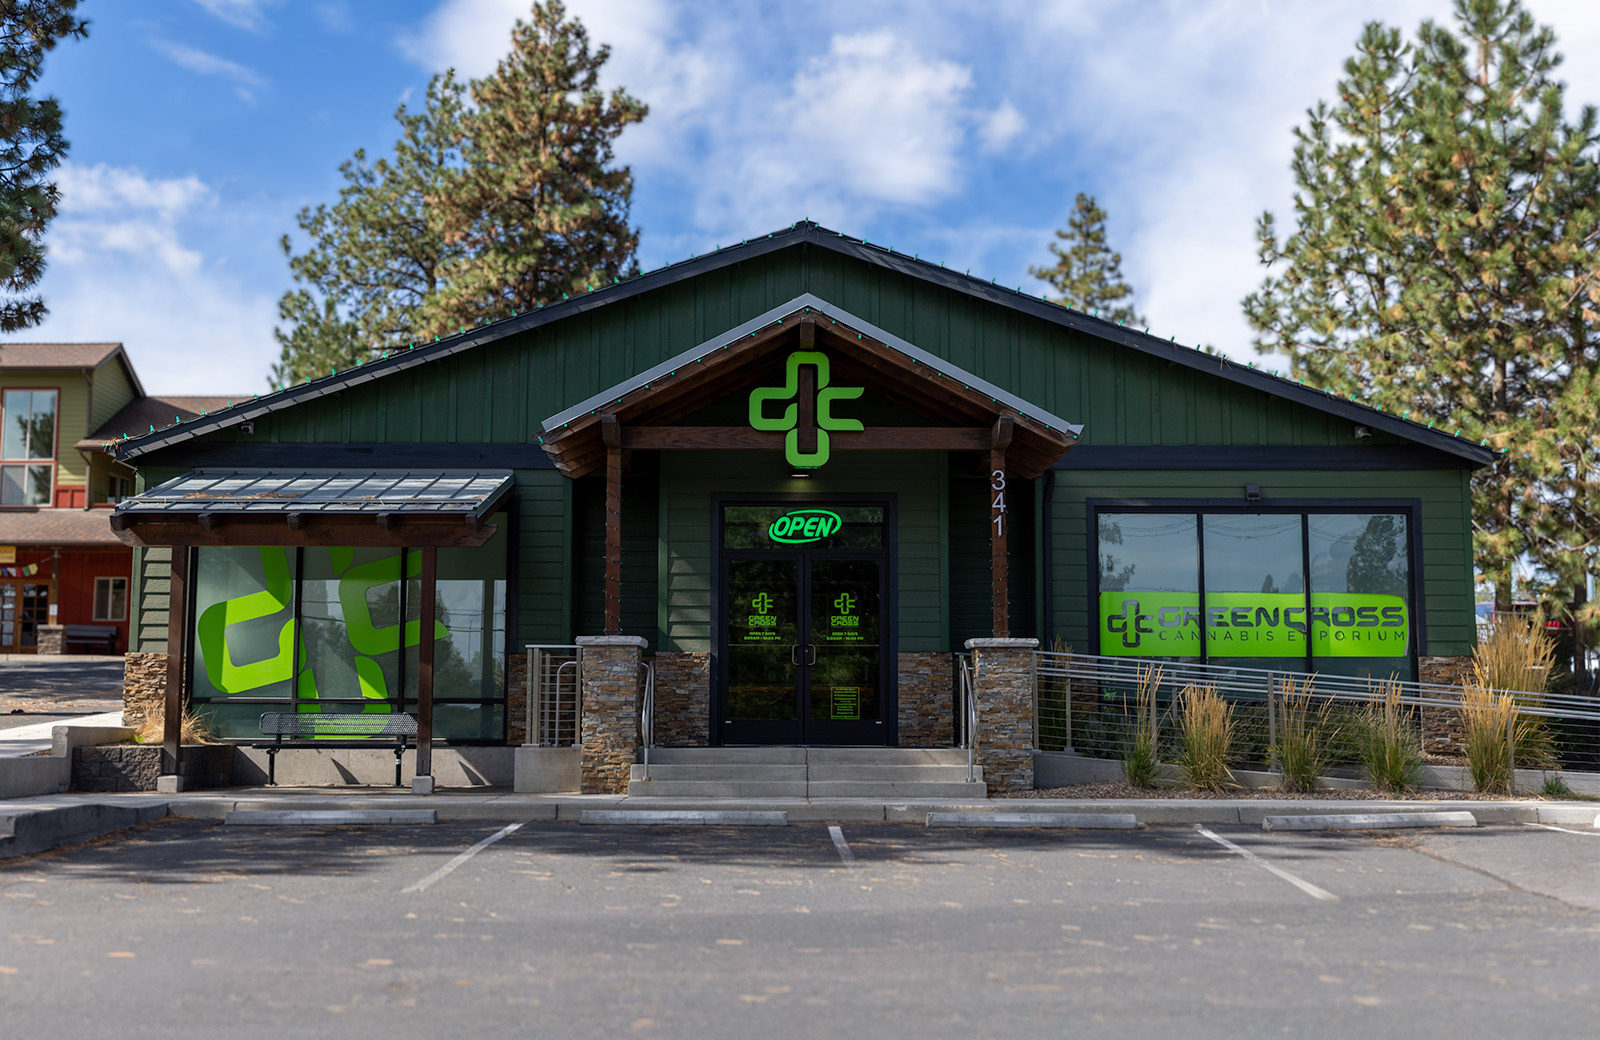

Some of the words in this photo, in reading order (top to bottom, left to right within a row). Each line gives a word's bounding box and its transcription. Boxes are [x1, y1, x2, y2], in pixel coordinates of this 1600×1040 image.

[991, 469, 1006, 536] 341
[774, 516, 834, 537] OPEN
[1158, 630, 1274, 642] CANNABIS
[1287, 630, 1405, 642] EPORIUM
